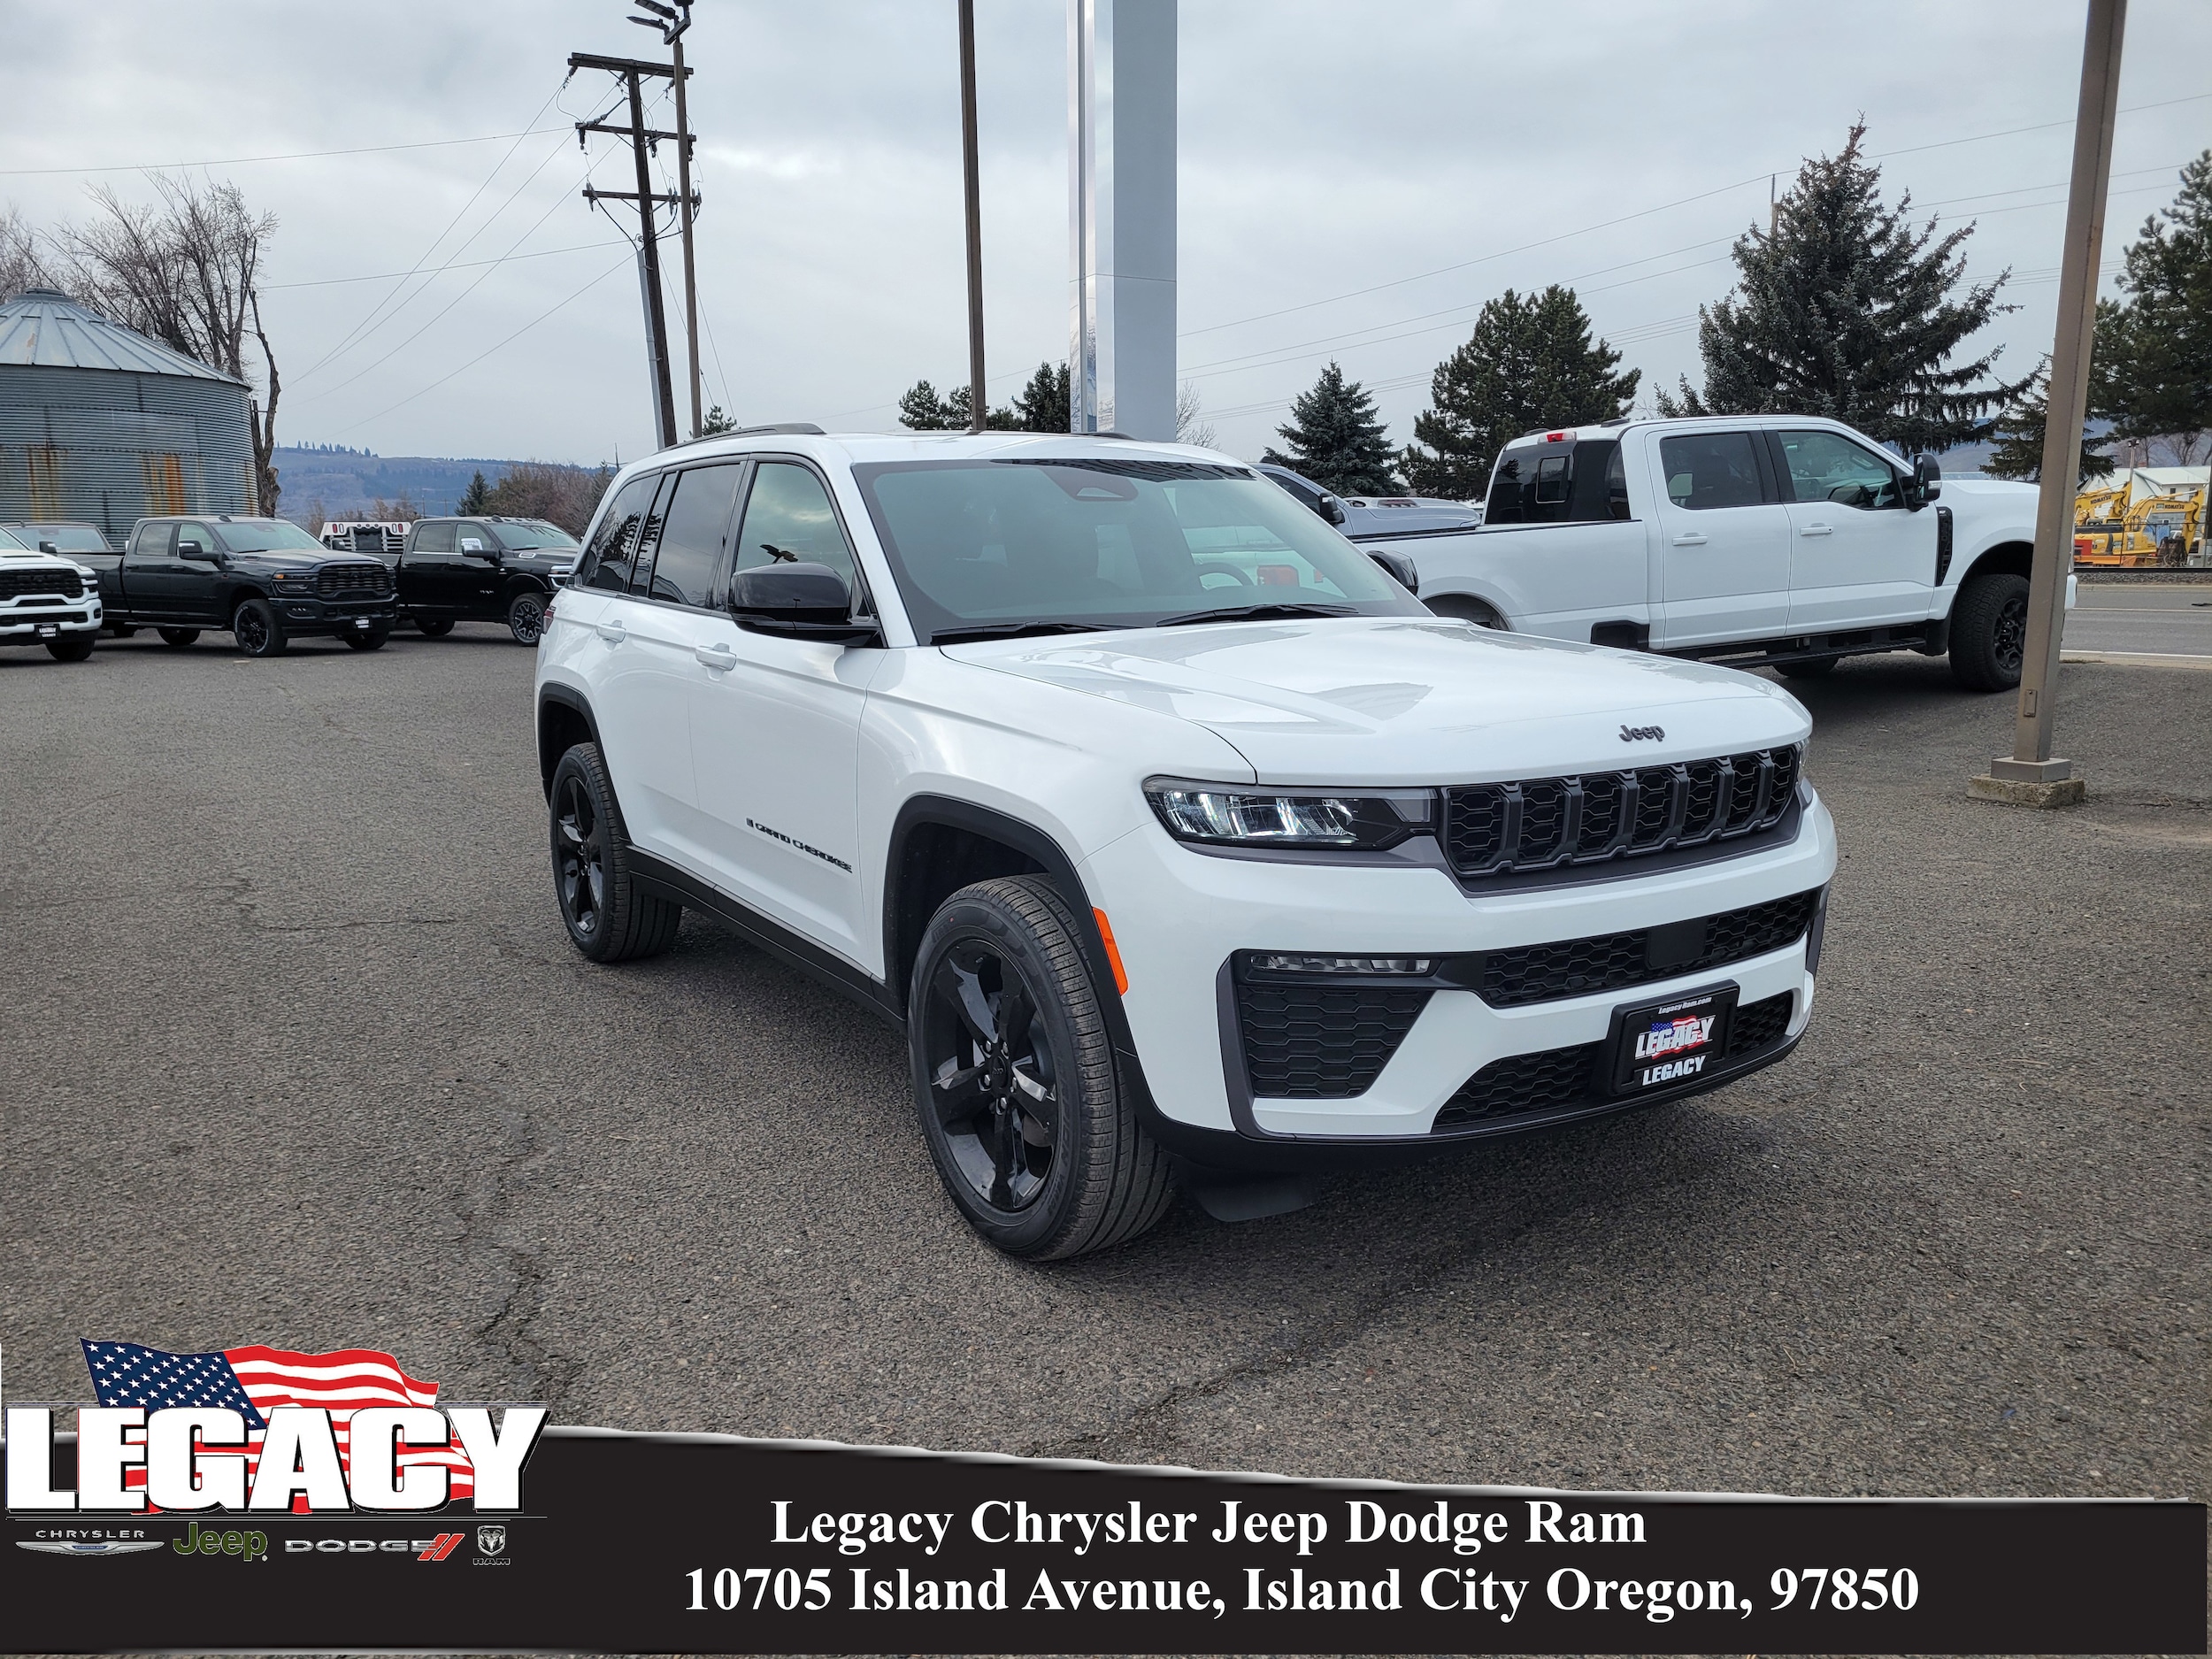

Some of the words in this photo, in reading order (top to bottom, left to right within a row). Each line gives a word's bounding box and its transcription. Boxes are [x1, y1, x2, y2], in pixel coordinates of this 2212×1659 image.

[1618, 724, 1665, 742] Jeep
[755, 822, 791, 844] GRAND
[792, 839, 853, 873] CHEROKEE
[1635, 1017, 1715, 1058] LEGACY
[1642, 1055, 1706, 1086] LEGACY
